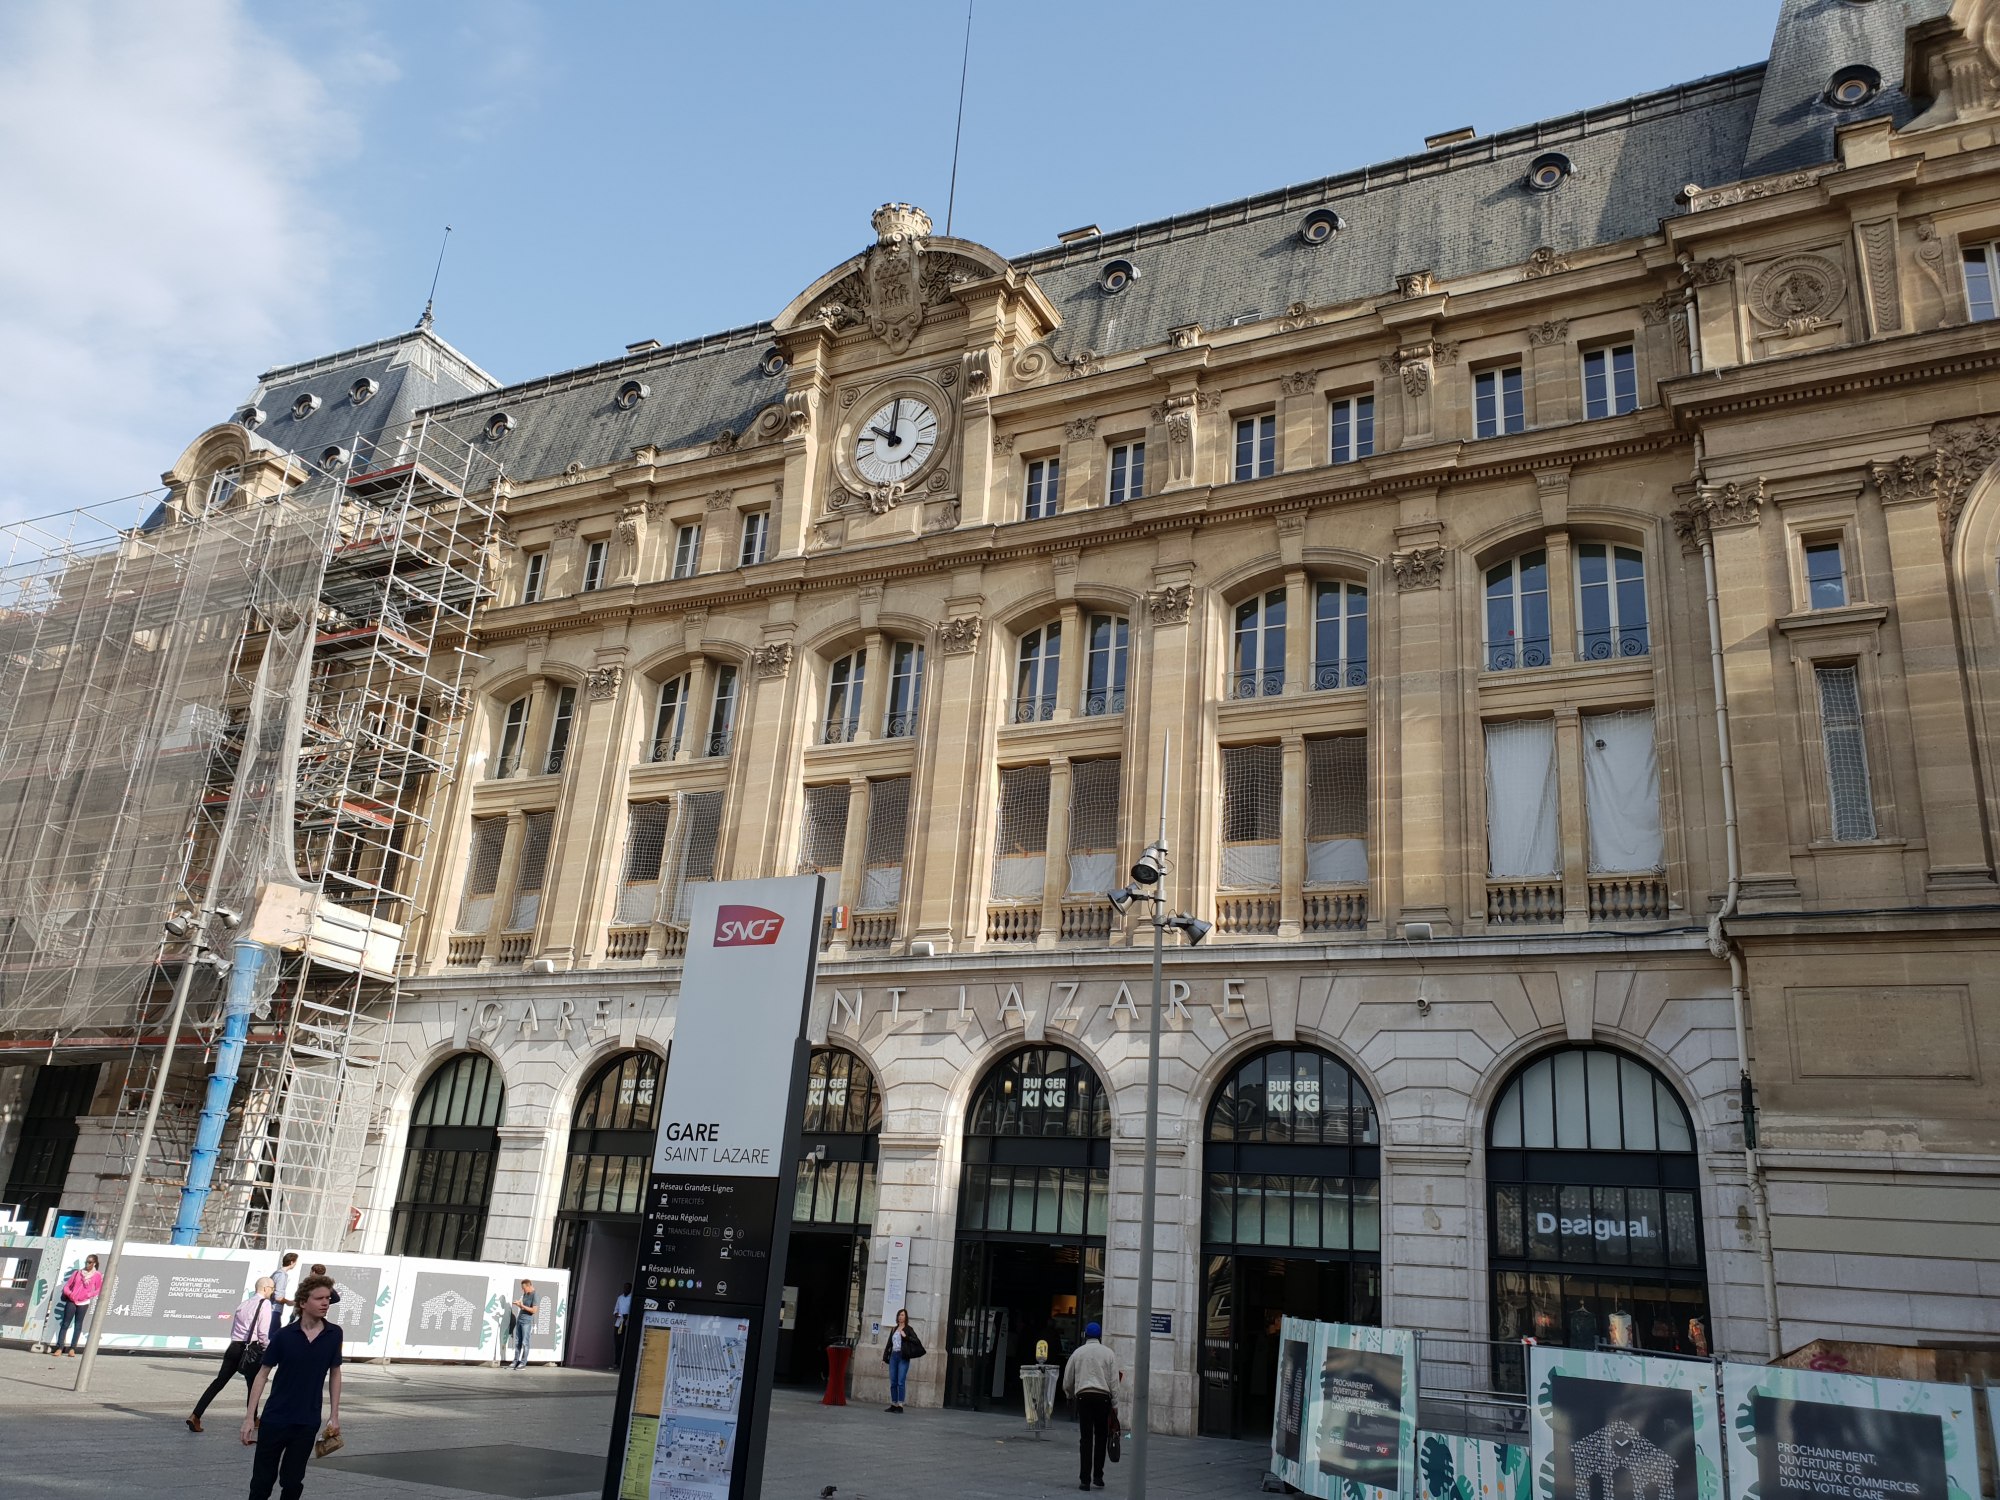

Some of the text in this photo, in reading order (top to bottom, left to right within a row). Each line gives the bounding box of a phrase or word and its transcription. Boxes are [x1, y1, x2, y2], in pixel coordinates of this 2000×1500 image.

[717, 916, 780, 942] SNCF
[480, 997, 611, 1032] GARE
[620, 1089, 653, 1104] KING
[808, 1090, 846, 1106] KING
[1022, 1090, 1066, 1107] KING
[1268, 1094, 1319, 1112] KING
[666, 1122, 720, 1142] GARE
[664, 1146, 770, 1164] SAINT LAZARE
[660, 1182, 734, 1194] Réseau Grandes Lignes
[671, 1197, 704, 1205] INTERCITÉS
[656, 1212, 708, 1223] Réseau Régional
[668, 1227, 700, 1236] TRANSILIEN
[733, 1249, 766, 1258] NOCTILIEN
[648, 1264, 695, 1275] Réseau Urbain
[645, 1316, 659, 1324] PLAN
[670, 1318, 687, 1326] GARE
[1332, 1386, 1366, 1399] OUVERTURE DE
[1332, 1395, 1389, 1411] NOUVEAUX COMMERCES
[1332, 1402, 1344, 1411] DANS
[1345, 1405, 1360, 1414] VOTRE
[1376, 1446, 1388, 1454] SNCF
[1778, 1442, 1877, 1465] PROCHAINEMENT,
[1778, 1454, 1862, 1474] OUVERTURE DE
[1779, 1466, 1920, 1493] NOUVEAUX COMMERCES
[1780, 1477, 1811, 1490] DANS
[1813, 1482, 1850, 1496] VOTRE
